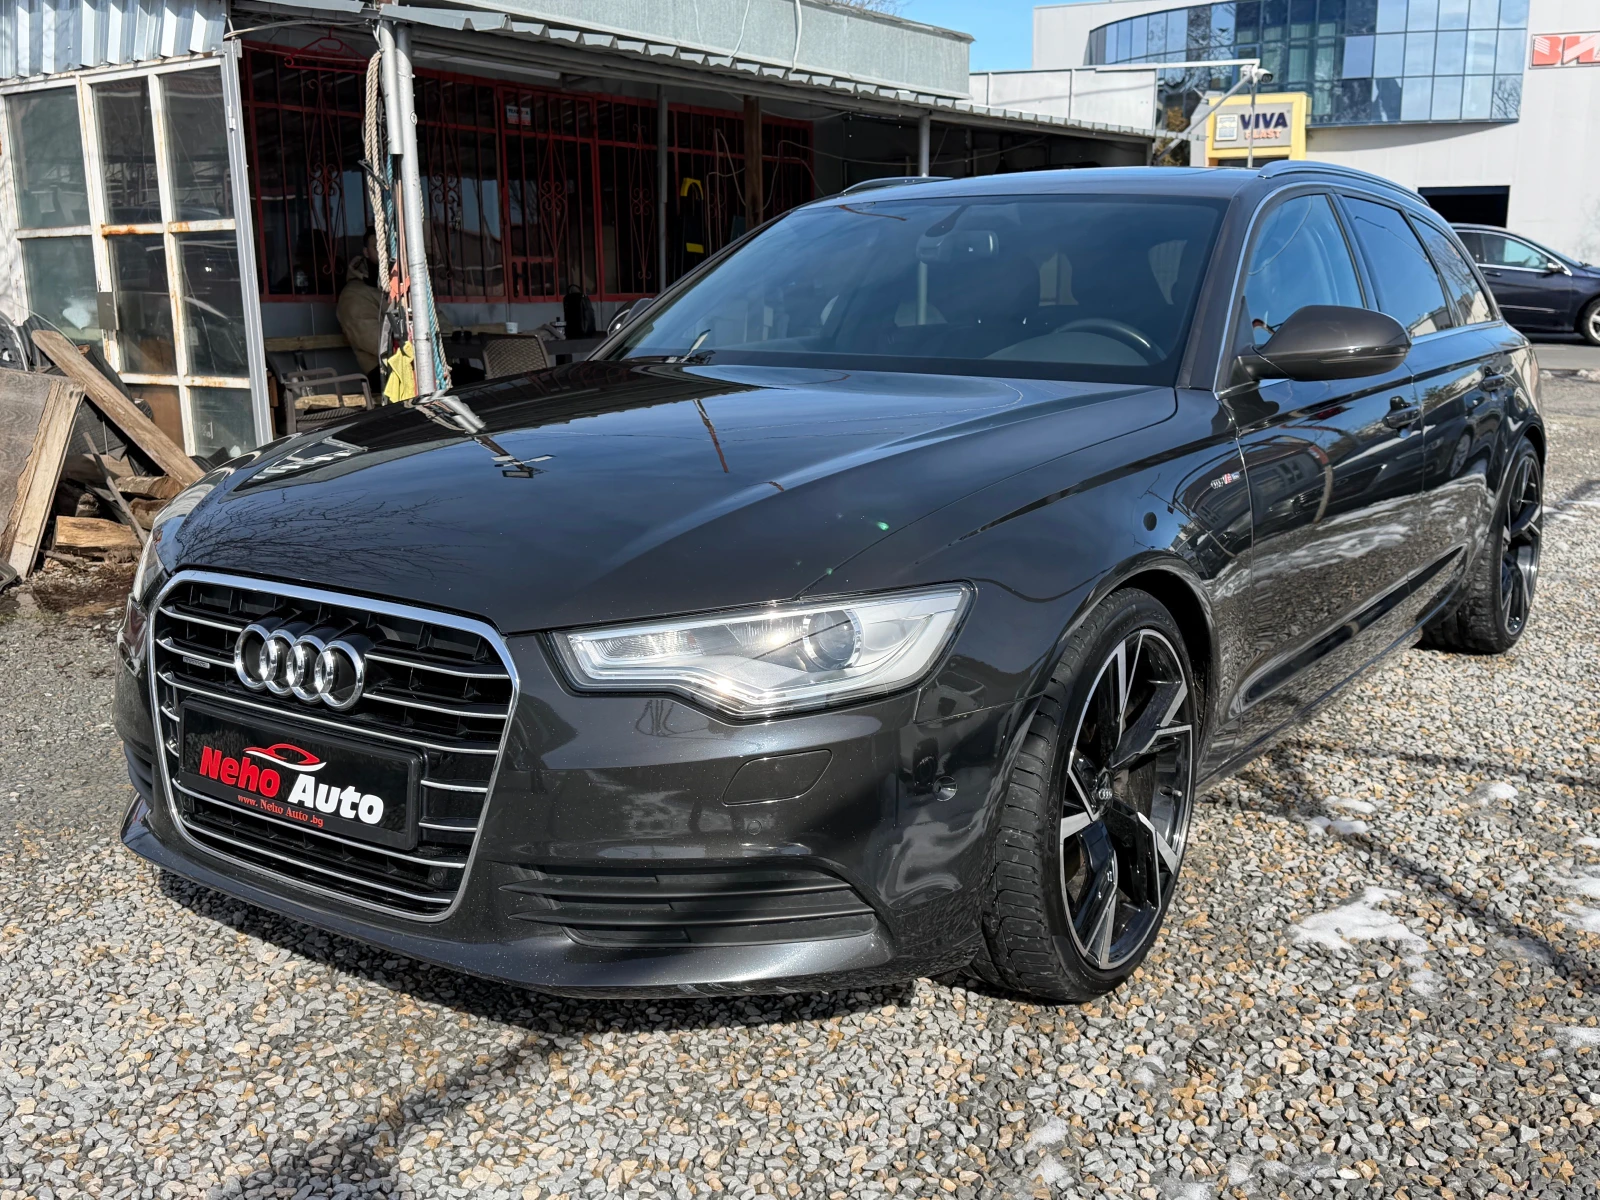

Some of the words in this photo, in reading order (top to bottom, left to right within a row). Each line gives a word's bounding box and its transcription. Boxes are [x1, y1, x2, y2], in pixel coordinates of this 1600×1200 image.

[1240, 112, 1288, 130] VIVA
[199, 745, 281, 798] Neho
[287, 773, 384, 825] Auto
[237, 794, 259, 807] www.
[260, 798, 284, 815] Neho
[285, 806, 309, 822] Auto
